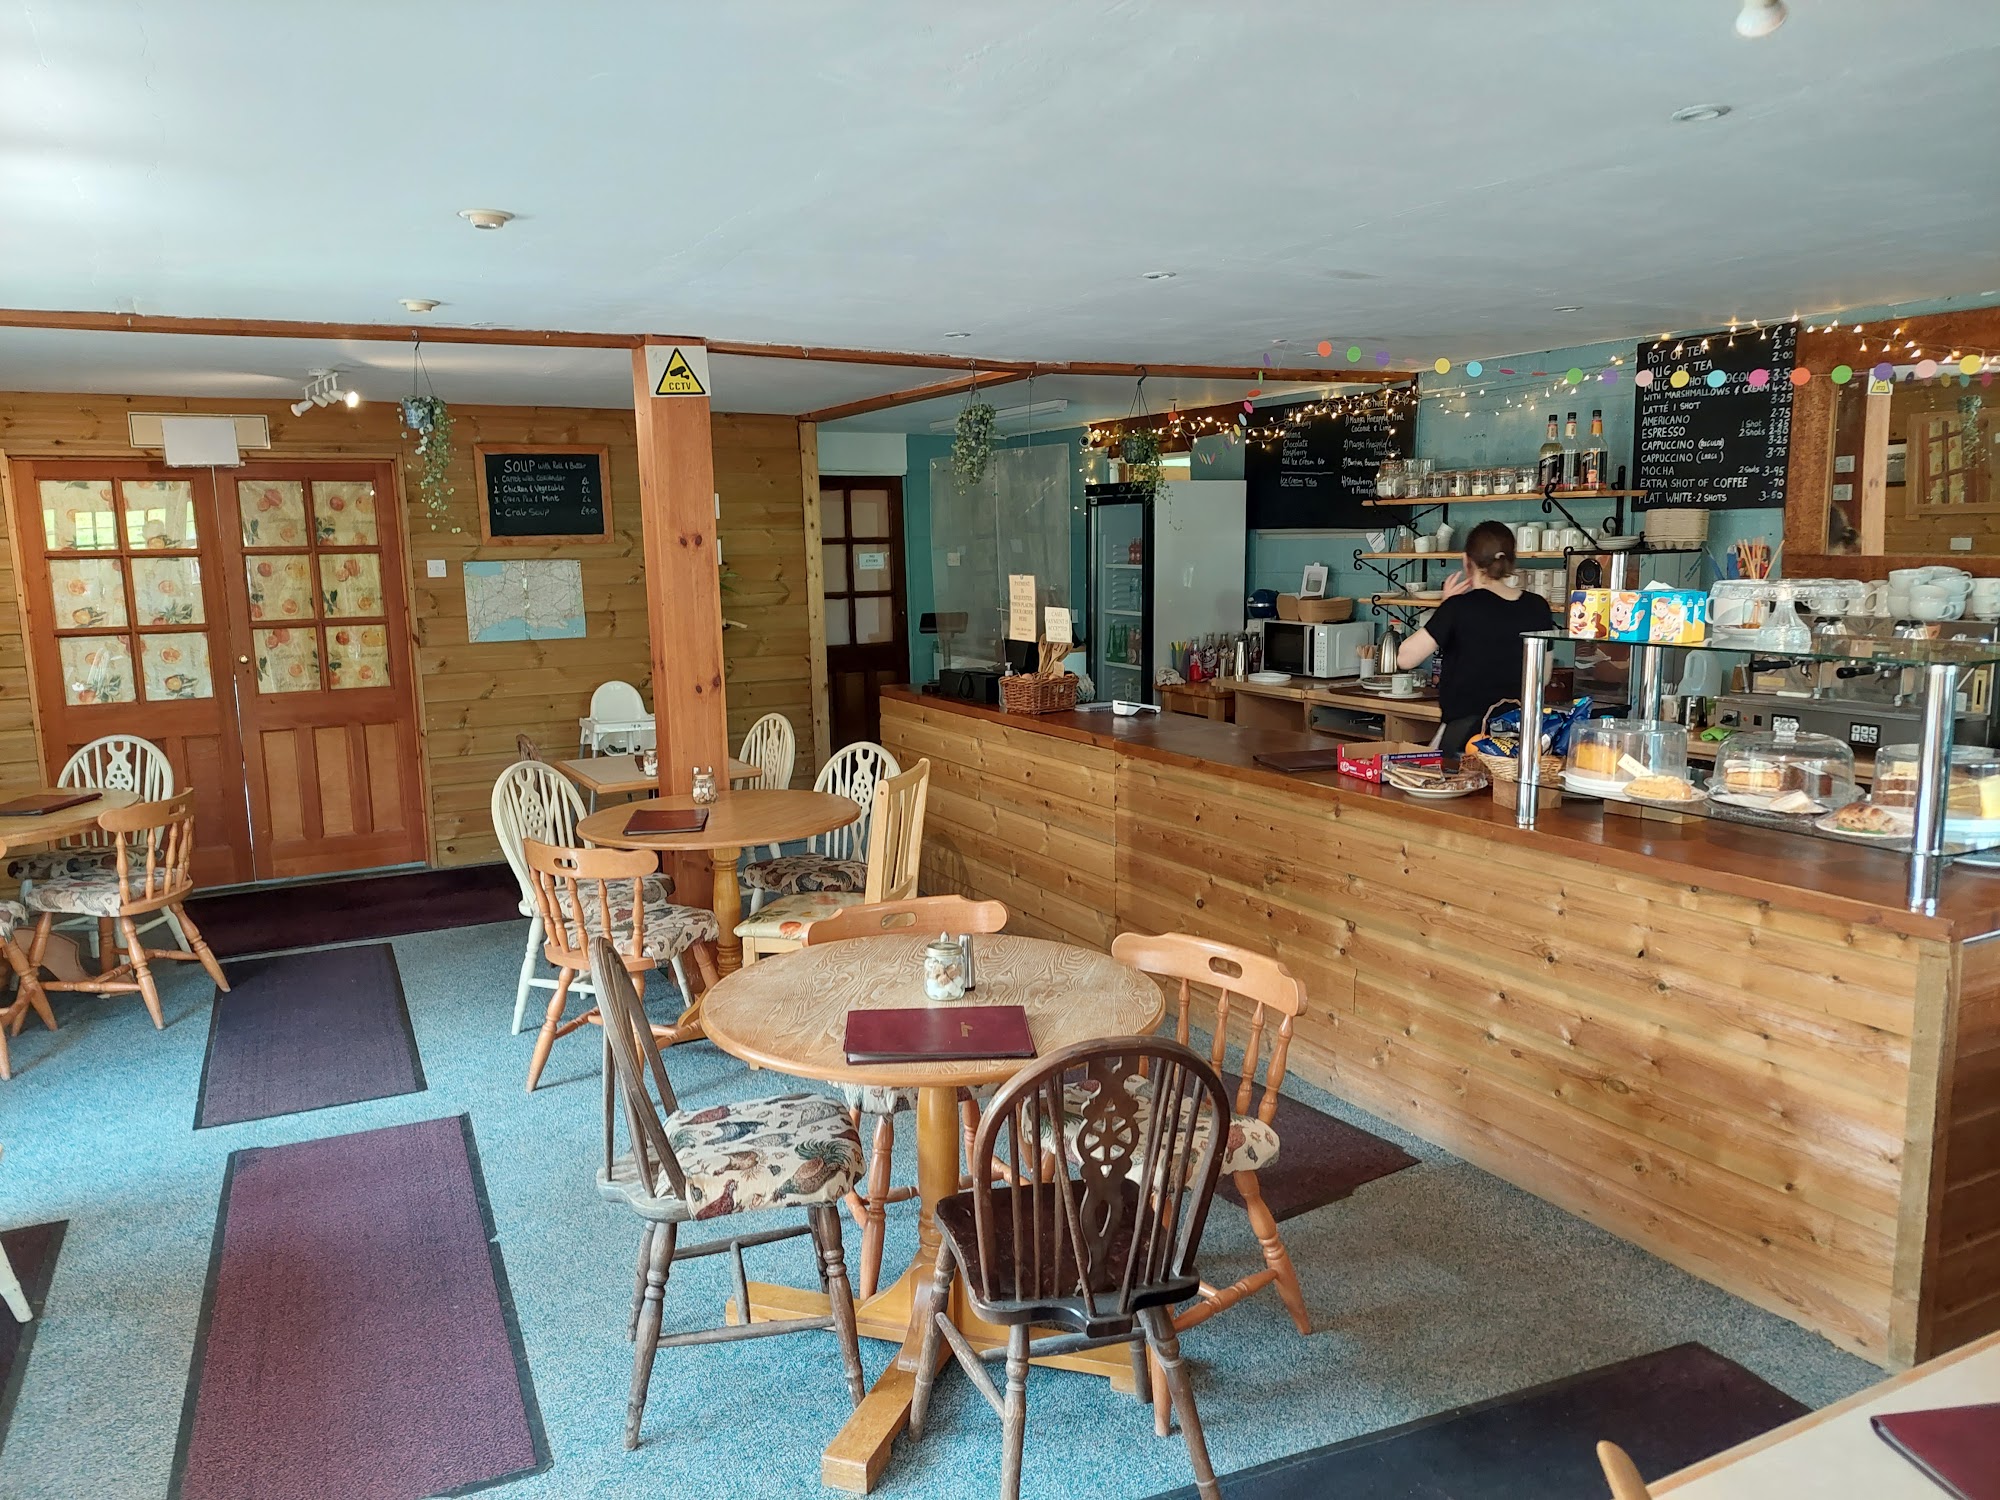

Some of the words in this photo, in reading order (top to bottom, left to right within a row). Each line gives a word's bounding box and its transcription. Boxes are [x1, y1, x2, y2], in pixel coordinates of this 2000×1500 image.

[1647, 350, 1666, 364] POT
[1670, 349, 1682, 361] OF
[1687, 345, 1706, 357] TEA
[1693, 360, 1713, 371] TEA
[669, 382, 690, 390] CCTV
[1690, 375, 1709, 387] HOT
[1644, 393, 1661, 402] WITH
[1665, 387, 1730, 399] MARSHMALLOWS
[1742, 383, 1770, 394] CREAM
[1680, 402, 1701, 410] SHOT
[1642, 415, 1690, 427] AMERICANO
[1642, 426, 1685, 439] ESPRESSO
[1283, 439, 1308, 448] Chocolate
[1642, 440, 1694, 450] CAPPUCCINO
[1641, 452, 1693, 463] CAPPUCCINO
[504, 459, 536, 473] SOUP
[1642, 466, 1674, 476] MOCHA
[1640, 478, 1668, 488] EXTRA
[1670, 478, 1695, 488] SHOT
[1698, 478, 1710, 488] OF
[1714, 477, 1748, 488] COFFEE
[1703, 493, 1728, 502] SHOTS
[505, 508, 526, 517] Crab
[529, 508, 550, 517] Soup
